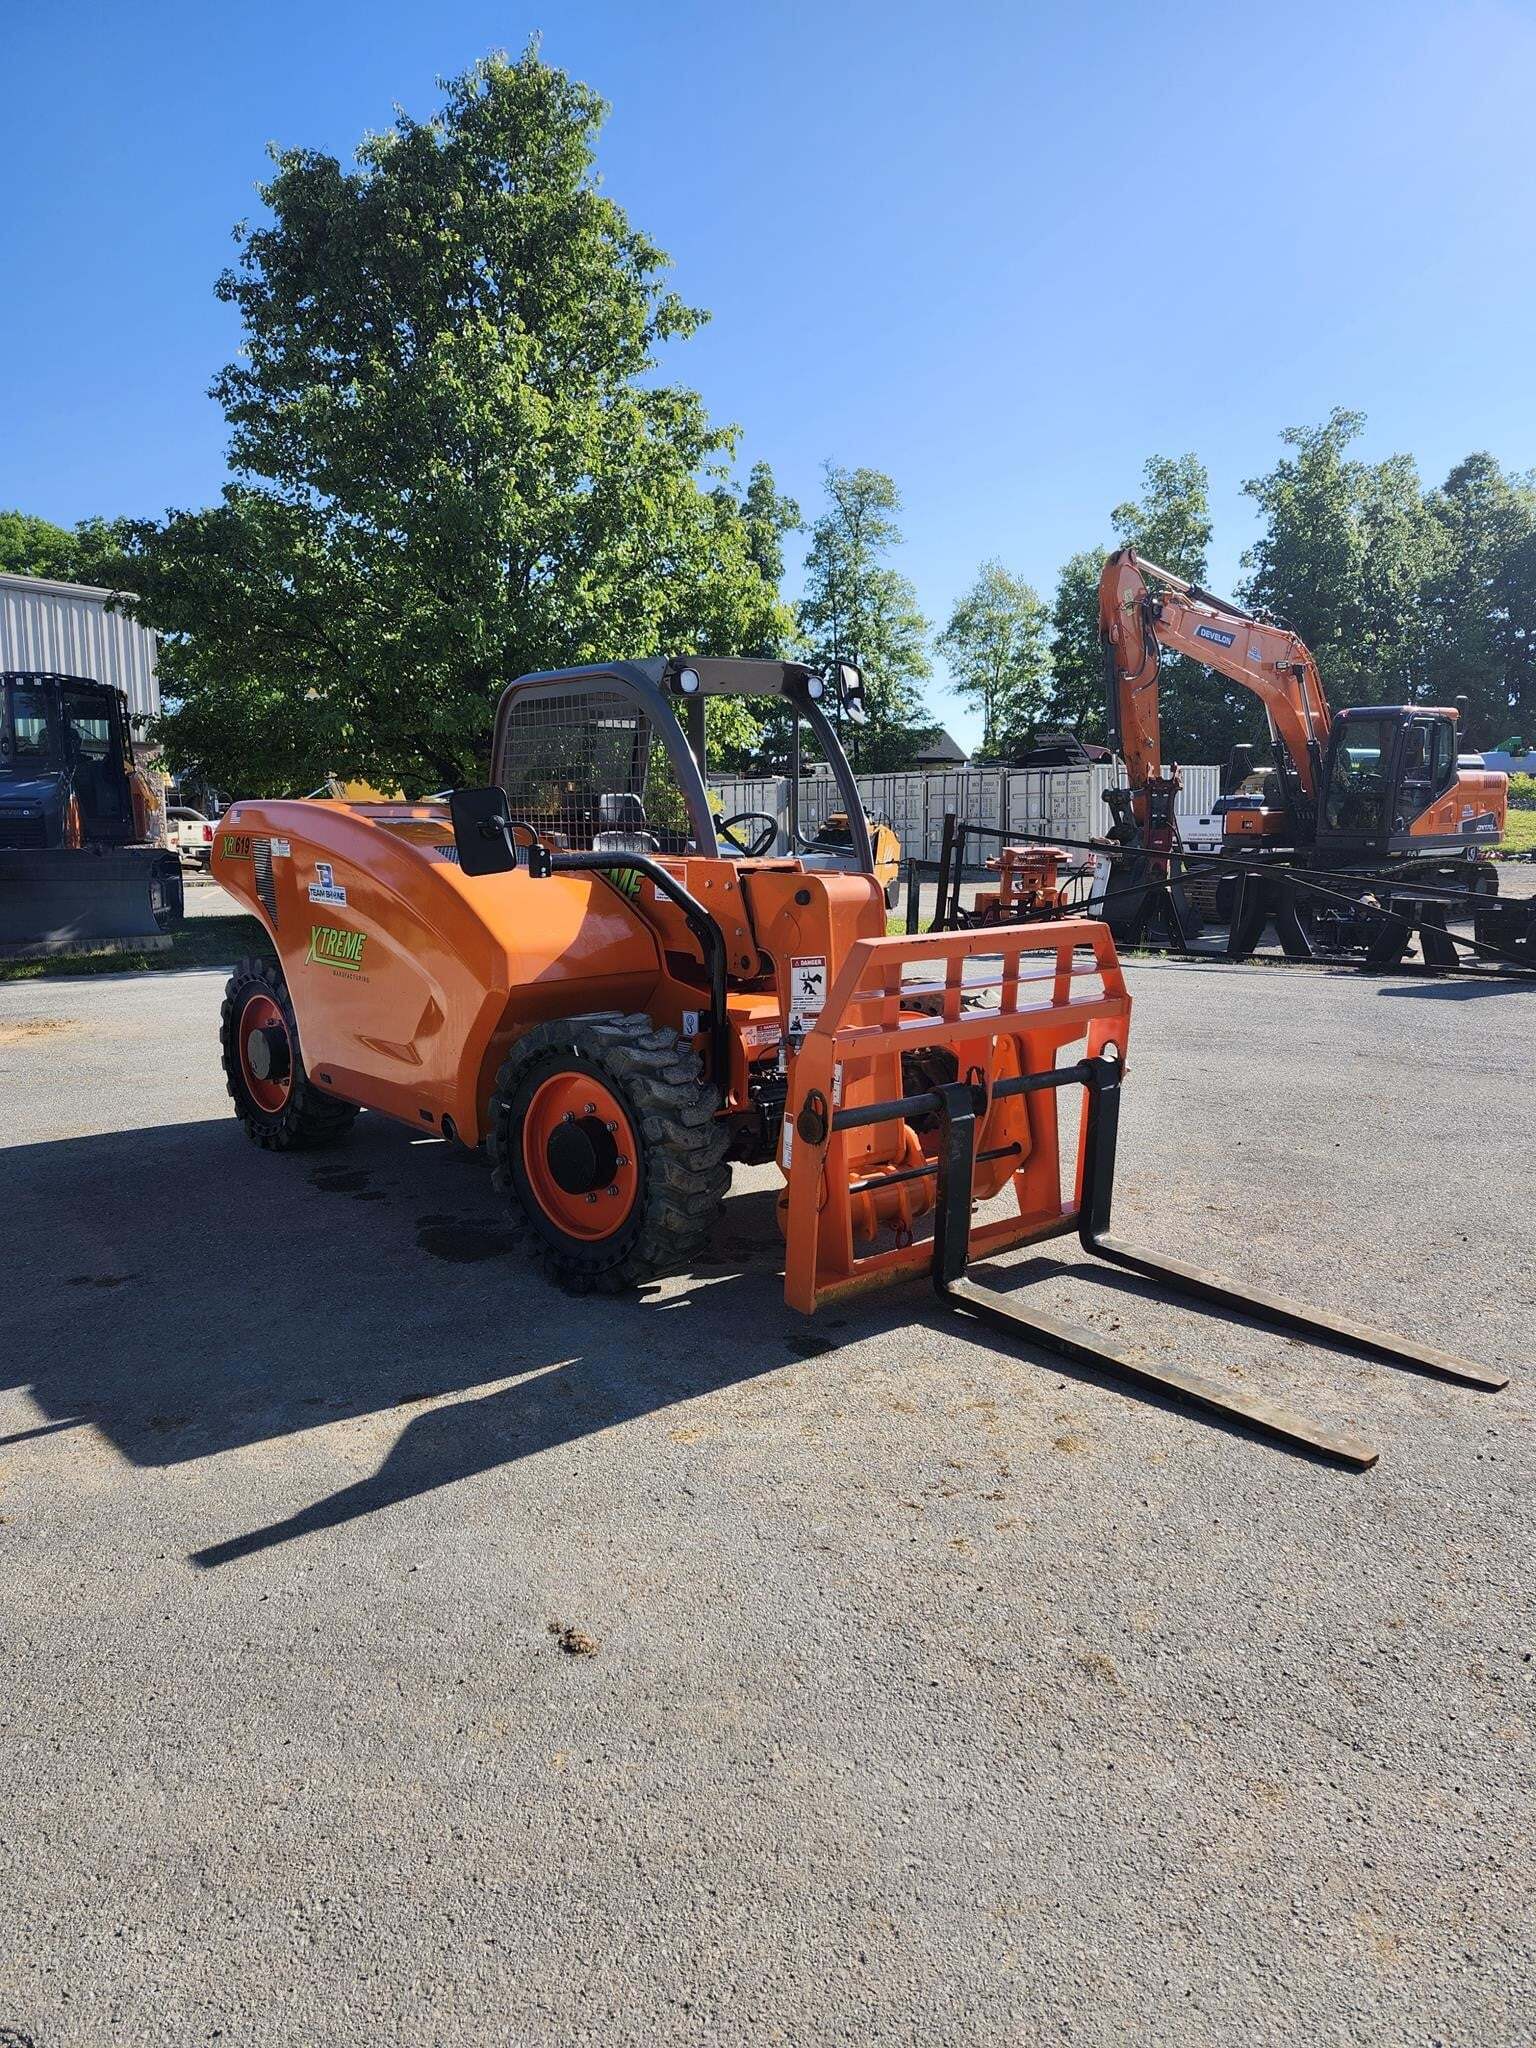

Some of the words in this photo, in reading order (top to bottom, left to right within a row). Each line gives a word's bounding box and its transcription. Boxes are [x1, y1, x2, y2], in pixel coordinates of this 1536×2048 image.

[1200, 628, 1232, 645] DEVELON
[309, 888, 325, 897] TEAM
[305, 926, 367, 967] XTREME
[333, 971, 369, 983] MANUFACTURING
